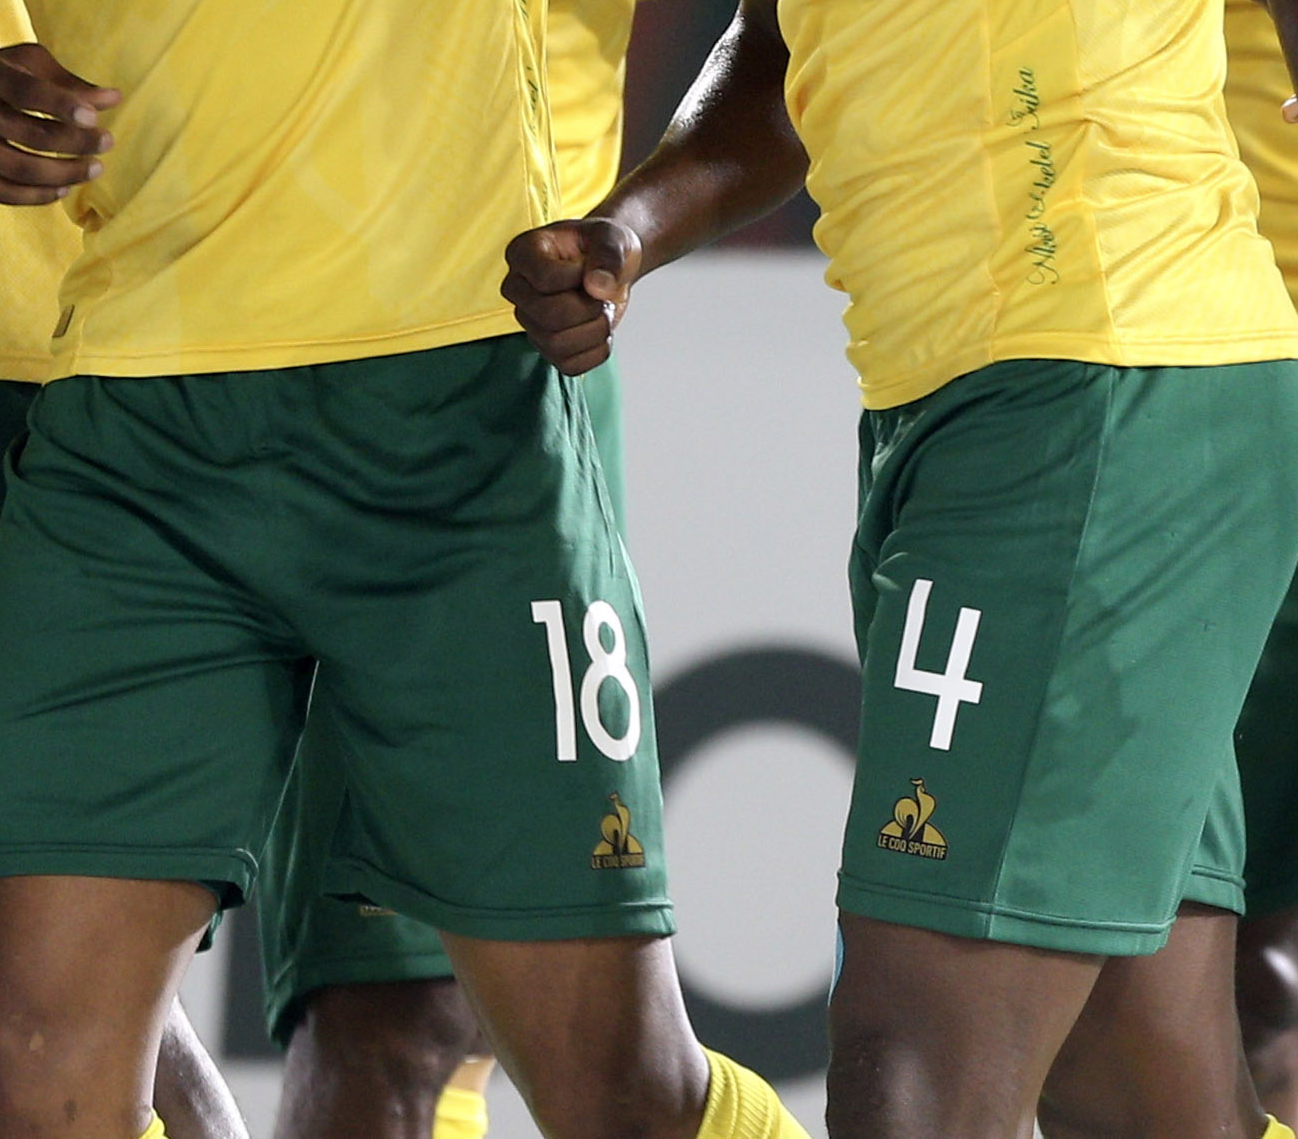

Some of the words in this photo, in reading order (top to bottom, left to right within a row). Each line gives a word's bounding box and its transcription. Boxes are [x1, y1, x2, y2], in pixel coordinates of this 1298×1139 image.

[530, 599, 642, 762] 18
[893, 578, 984, 752] 4
[878, 835, 888, 848] LE
[888, 837, 908, 853] COQ
[907, 841, 948, 860] SPORTIF
